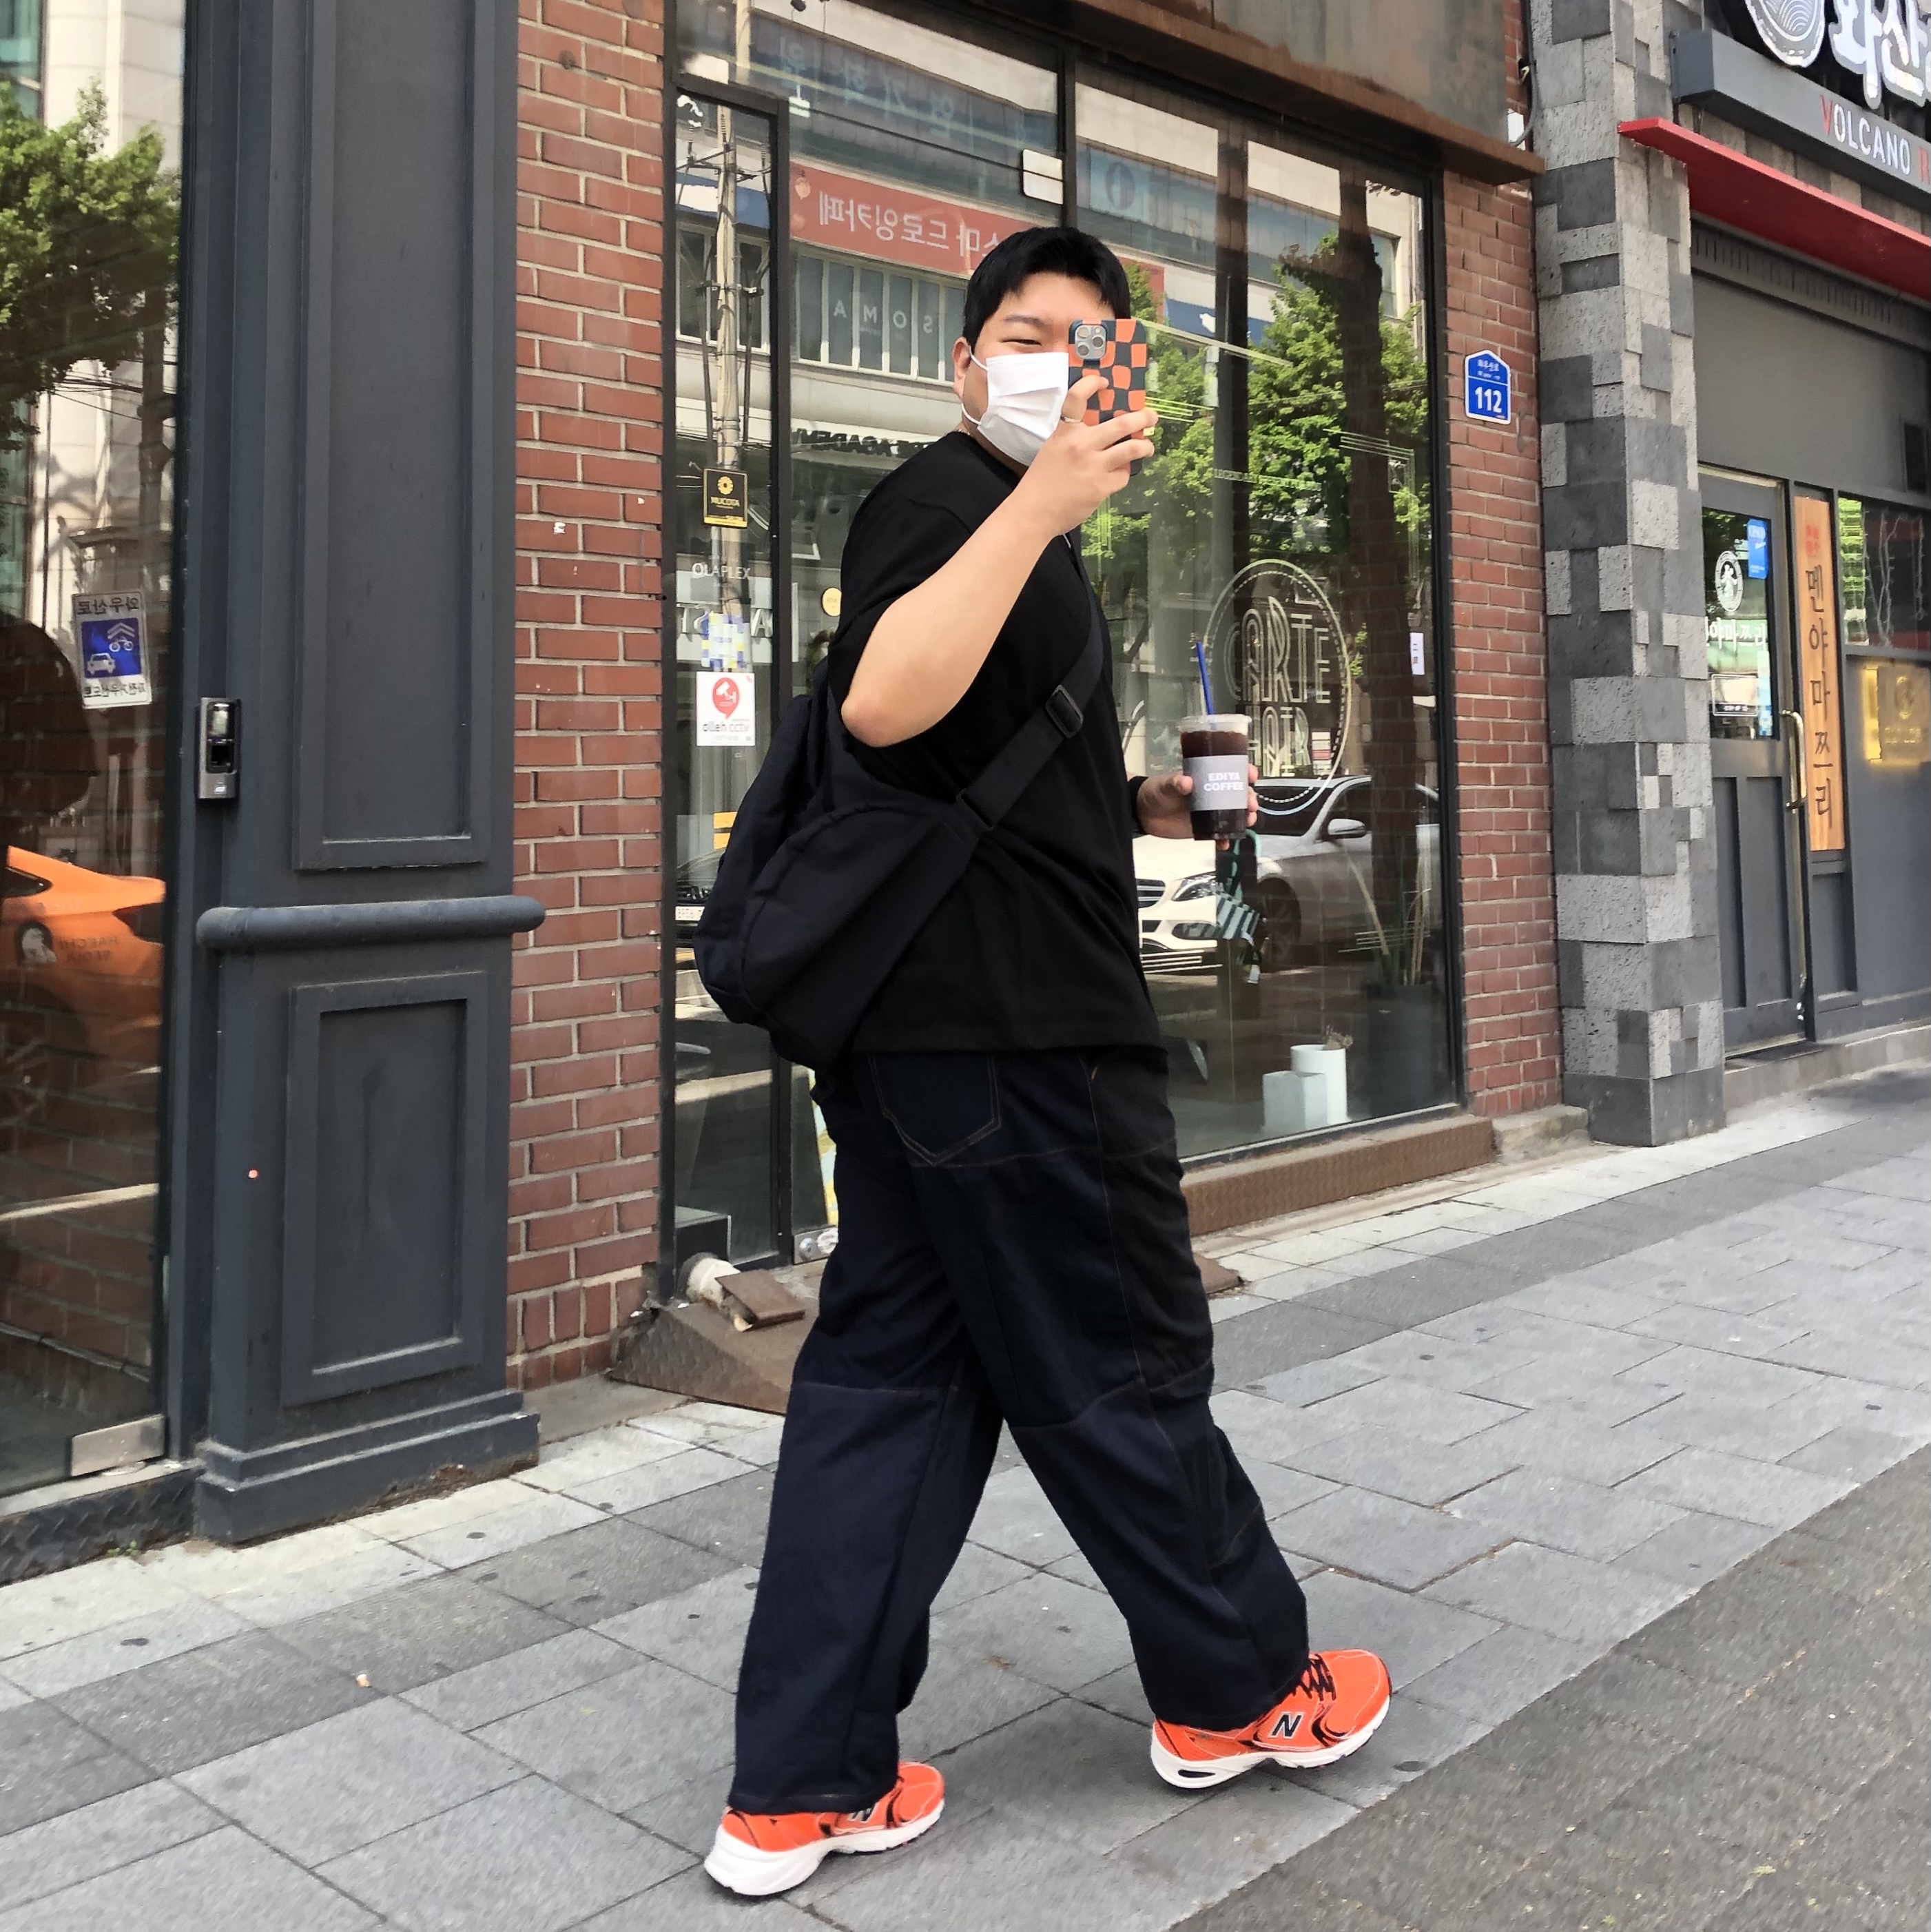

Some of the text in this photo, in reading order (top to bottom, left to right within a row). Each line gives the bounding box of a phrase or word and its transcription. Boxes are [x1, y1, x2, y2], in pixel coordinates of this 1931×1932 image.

[1819, 94, 1911, 175] VOLCANO
[1475, 387, 1502, 413] 112
[692, 563, 751, 579] OLAPLEX
[1705, 616, 1767, 651] 야마쯔리
[1223, 596, 1331, 703] CARTE
[1203, 782, 1244, 792] COFFEE
[1208, 772, 1241, 781] EDIYA
[1268, 1712, 1305, 1739] N
